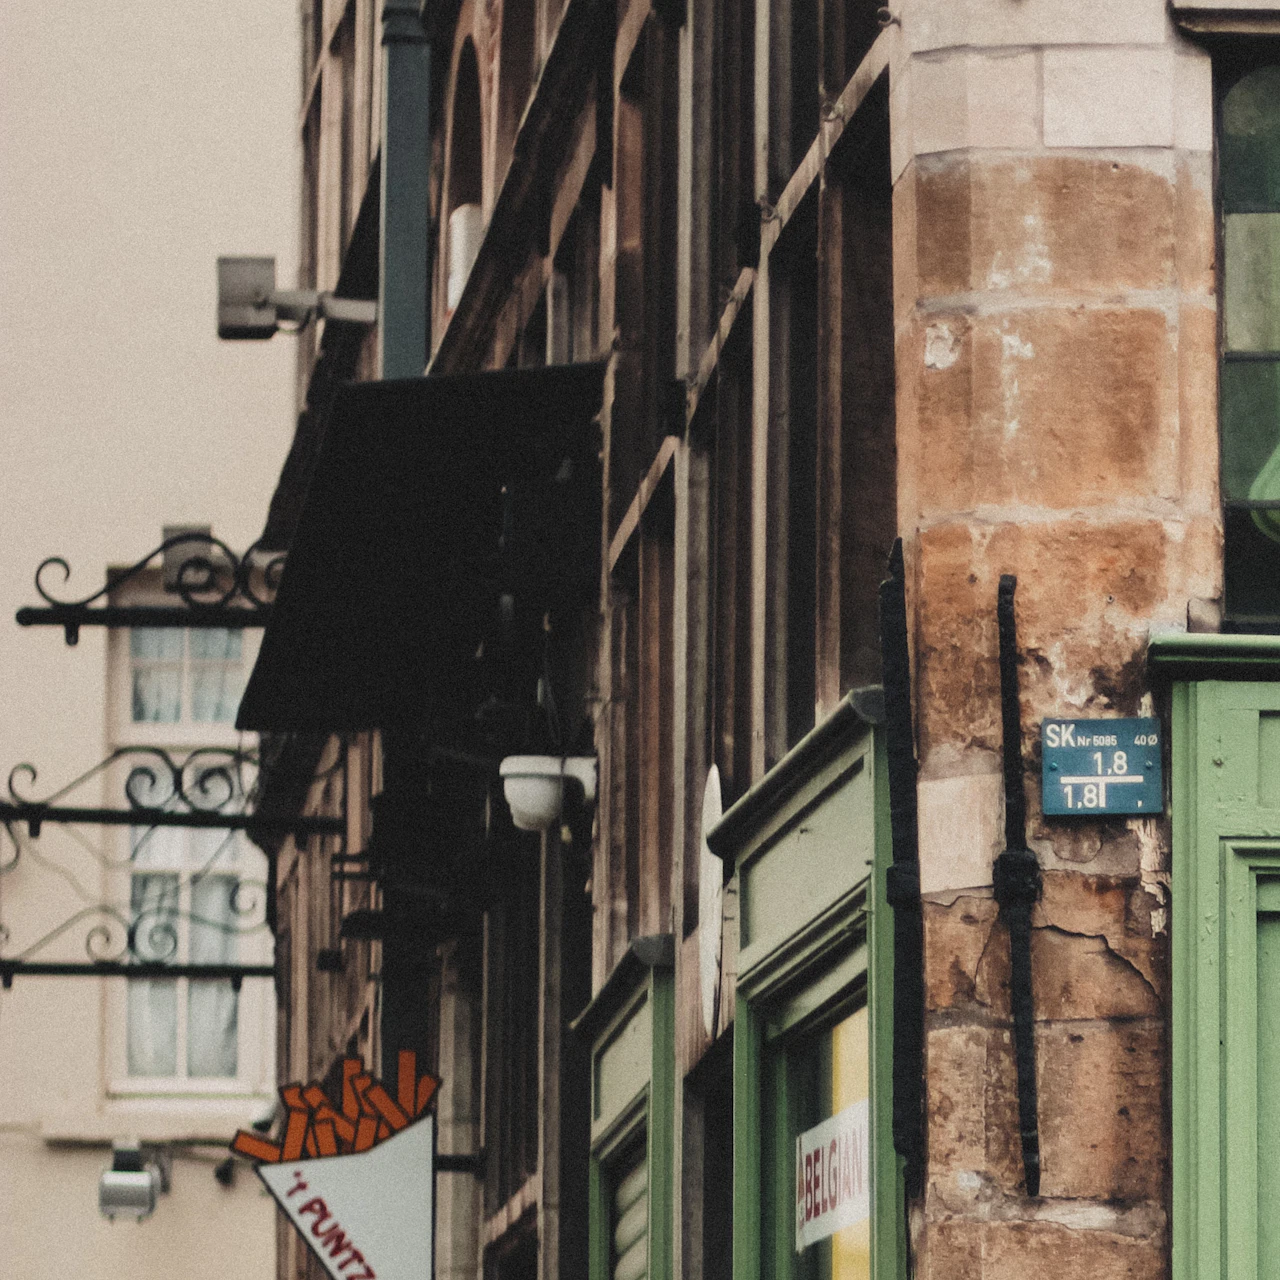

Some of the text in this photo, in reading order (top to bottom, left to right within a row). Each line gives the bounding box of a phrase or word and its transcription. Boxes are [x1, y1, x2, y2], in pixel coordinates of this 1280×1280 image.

[1046, 723, 1076, 748] SK
[1077, 736, 1092, 746] Nr
[1093, 751, 1128, 775] 1,8
